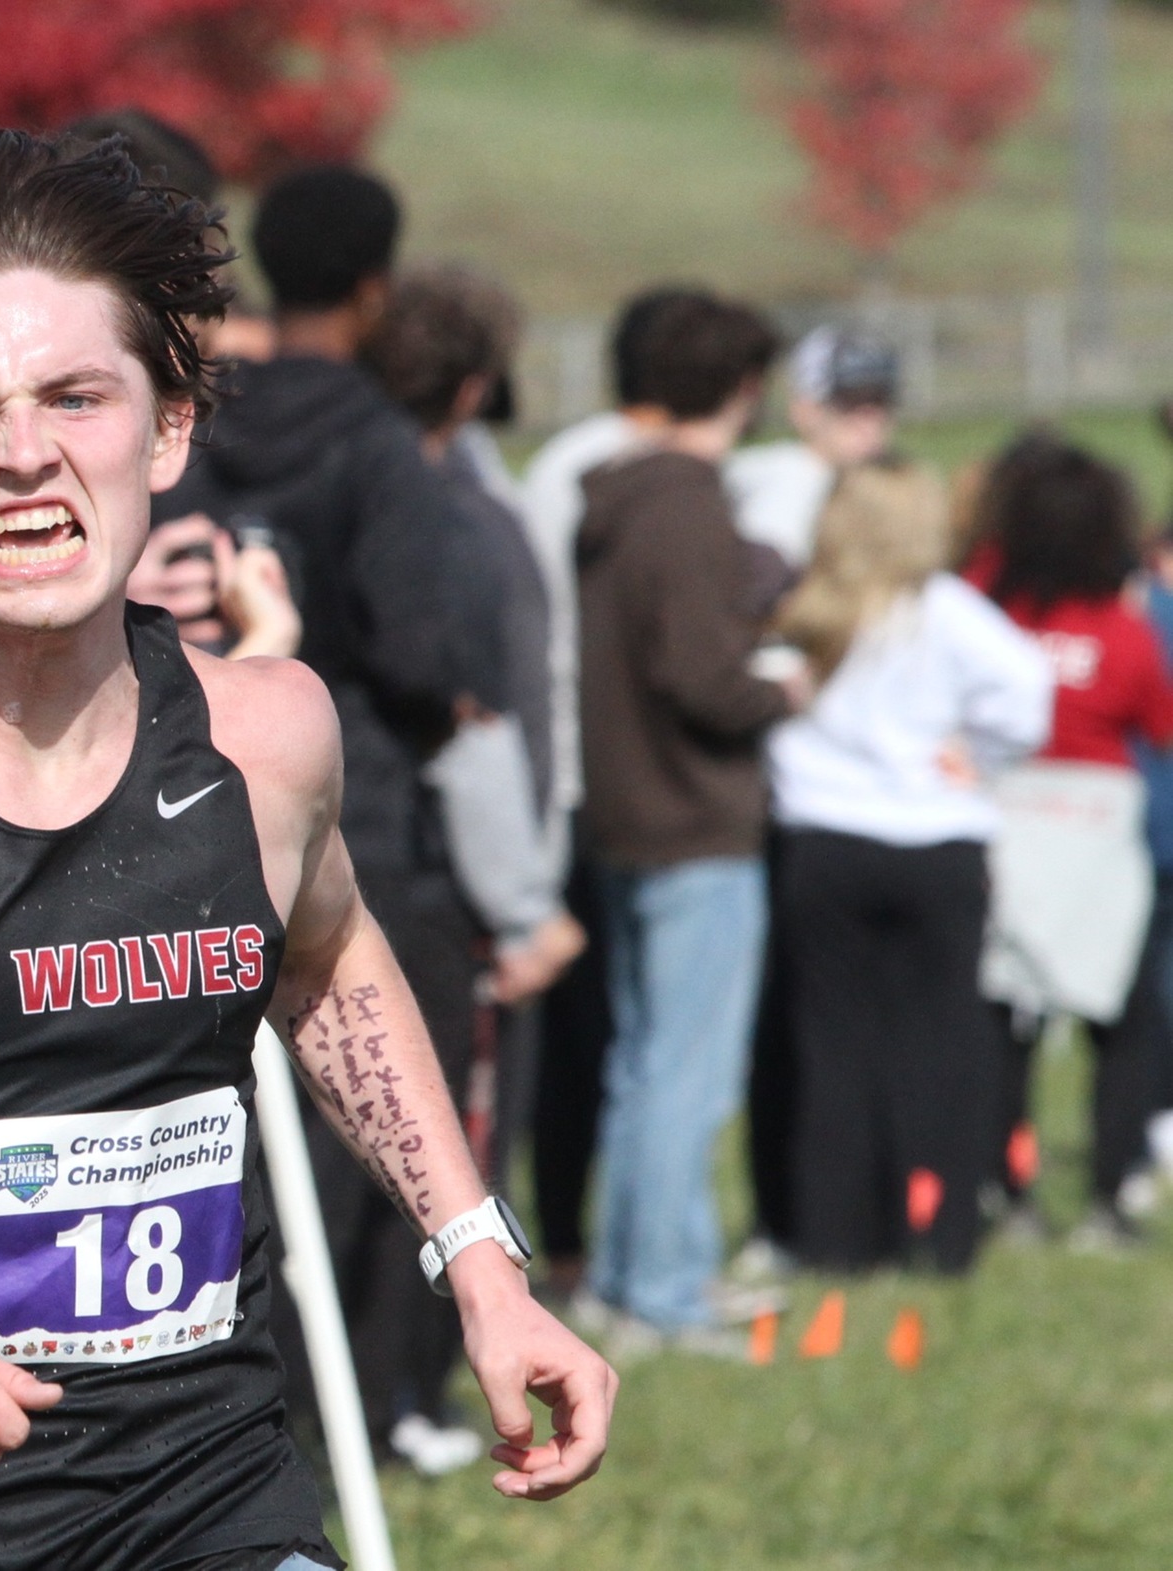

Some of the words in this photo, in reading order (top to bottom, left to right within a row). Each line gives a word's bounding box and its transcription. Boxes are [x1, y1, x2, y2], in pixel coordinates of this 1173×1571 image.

[11, 924, 265, 1014] WOLVES
[364, 1032, 389, 1062] be
[69, 1135, 143, 1156] Cross
[149, 1113, 232, 1147] Country
[8, 1152, 46, 1164] RIVER
[67, 1140, 233, 1185] Championship
[29, 1188, 49, 1208] 2025
[55, 1204, 184, 1317] 18
